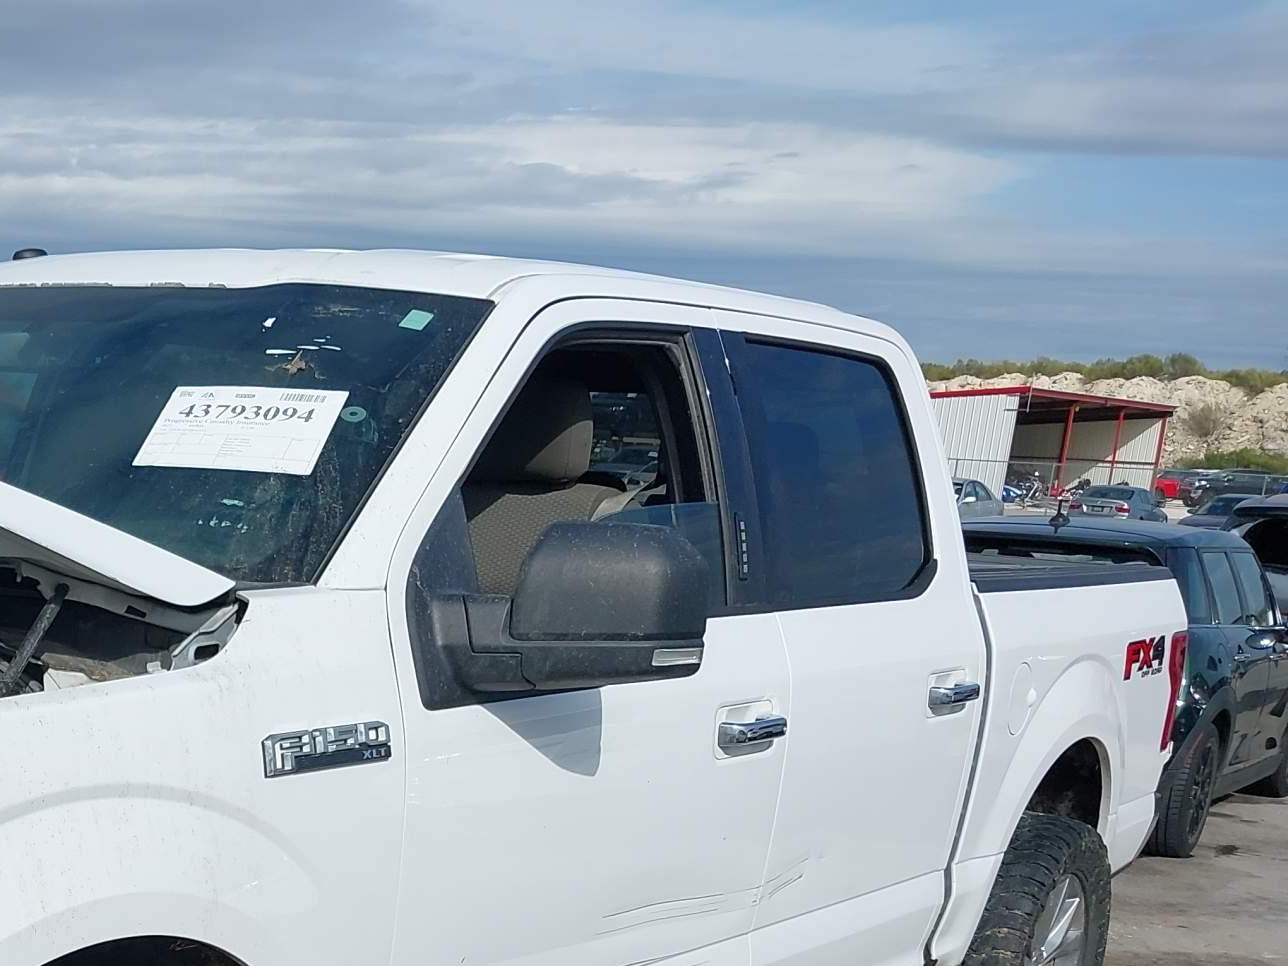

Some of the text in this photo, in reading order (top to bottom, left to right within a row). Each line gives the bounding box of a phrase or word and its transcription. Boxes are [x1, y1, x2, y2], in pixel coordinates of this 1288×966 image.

[178, 404, 316, 422] 43793094
[1123, 635, 1165, 680] FX4
[362, 749, 387, 760] XLT
